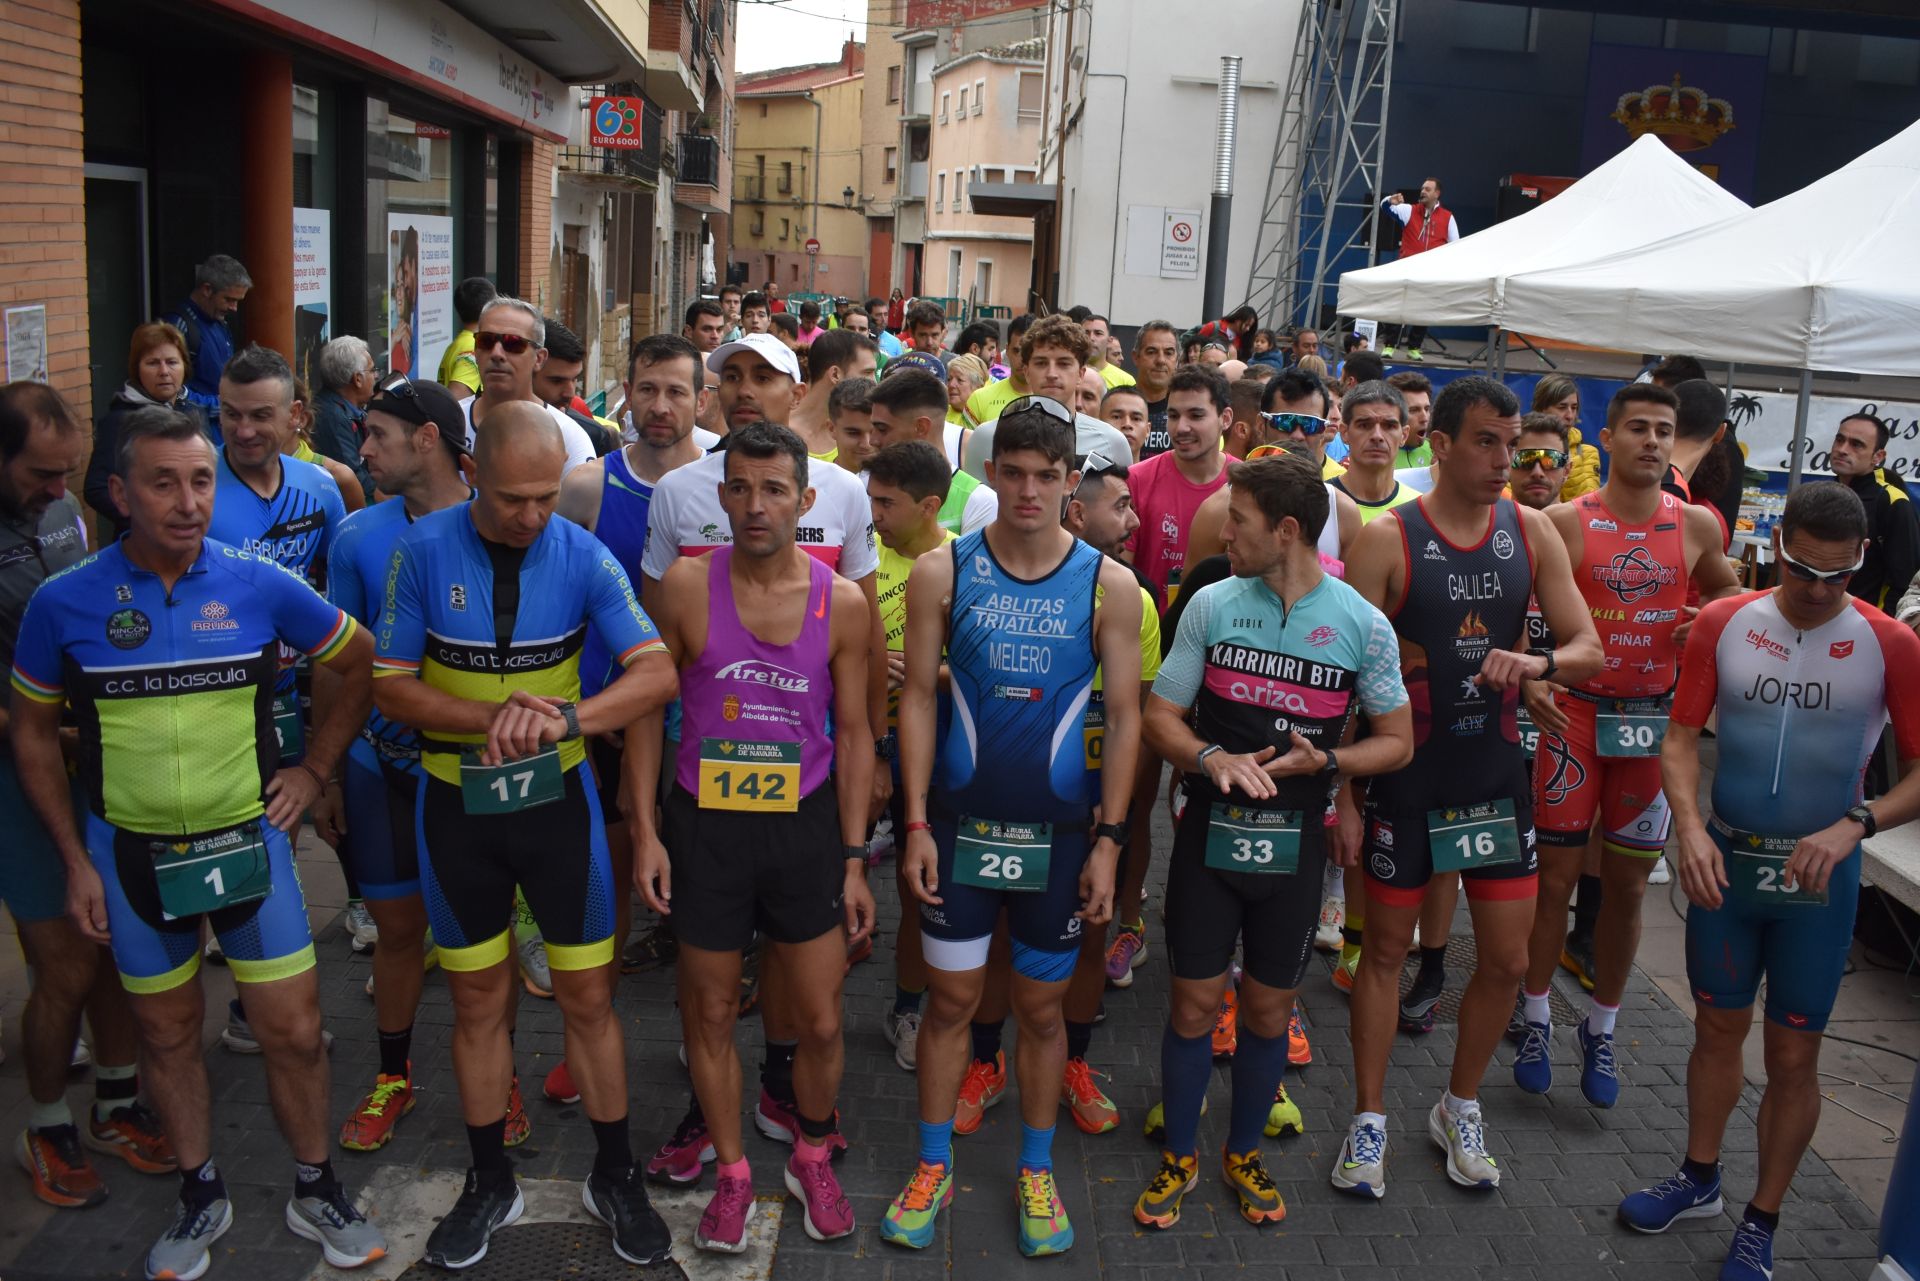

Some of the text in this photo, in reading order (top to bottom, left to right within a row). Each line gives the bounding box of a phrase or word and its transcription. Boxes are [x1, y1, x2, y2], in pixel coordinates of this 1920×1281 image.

[593, 136, 639, 146] EURO 6000
[1448, 571, 1503, 600] GALILEA
[985, 593, 1065, 615] ABLITAS
[191, 620, 239, 632] BRUNA
[975, 611, 1067, 635] TRIATLÓN
[1232, 618, 1262, 629] GOBIK
[1609, 632, 1652, 647] PIÑAR
[440, 649, 464, 665] c.c.
[469, 652, 486, 667] la
[989, 642, 1052, 674] MELERO
[1211, 644, 1304, 682] KARRIKIRI
[1310, 665, 1344, 689] BTT
[105, 667, 247, 694] c.c. la bascula
[1744, 674, 1831, 711] JORDI
[742, 702, 800, 717] Ayuntamiento de
[1230, 680, 1310, 714] ariza
[741, 712, 769, 722] Albelda
[769, 714, 779, 722] de
[1618, 725, 1653, 748] 30
[490, 770, 535, 802] 17
[714, 771, 786, 801] 142
[195, 835, 243, 852] DE NAVARRA
[1003, 832, 1035, 840] NAVARRA
[1455, 831, 1495, 858] 16
[1231, 838, 1274, 864] 33
[979, 852, 1023, 880] 26
[204, 867, 225, 896] 1
